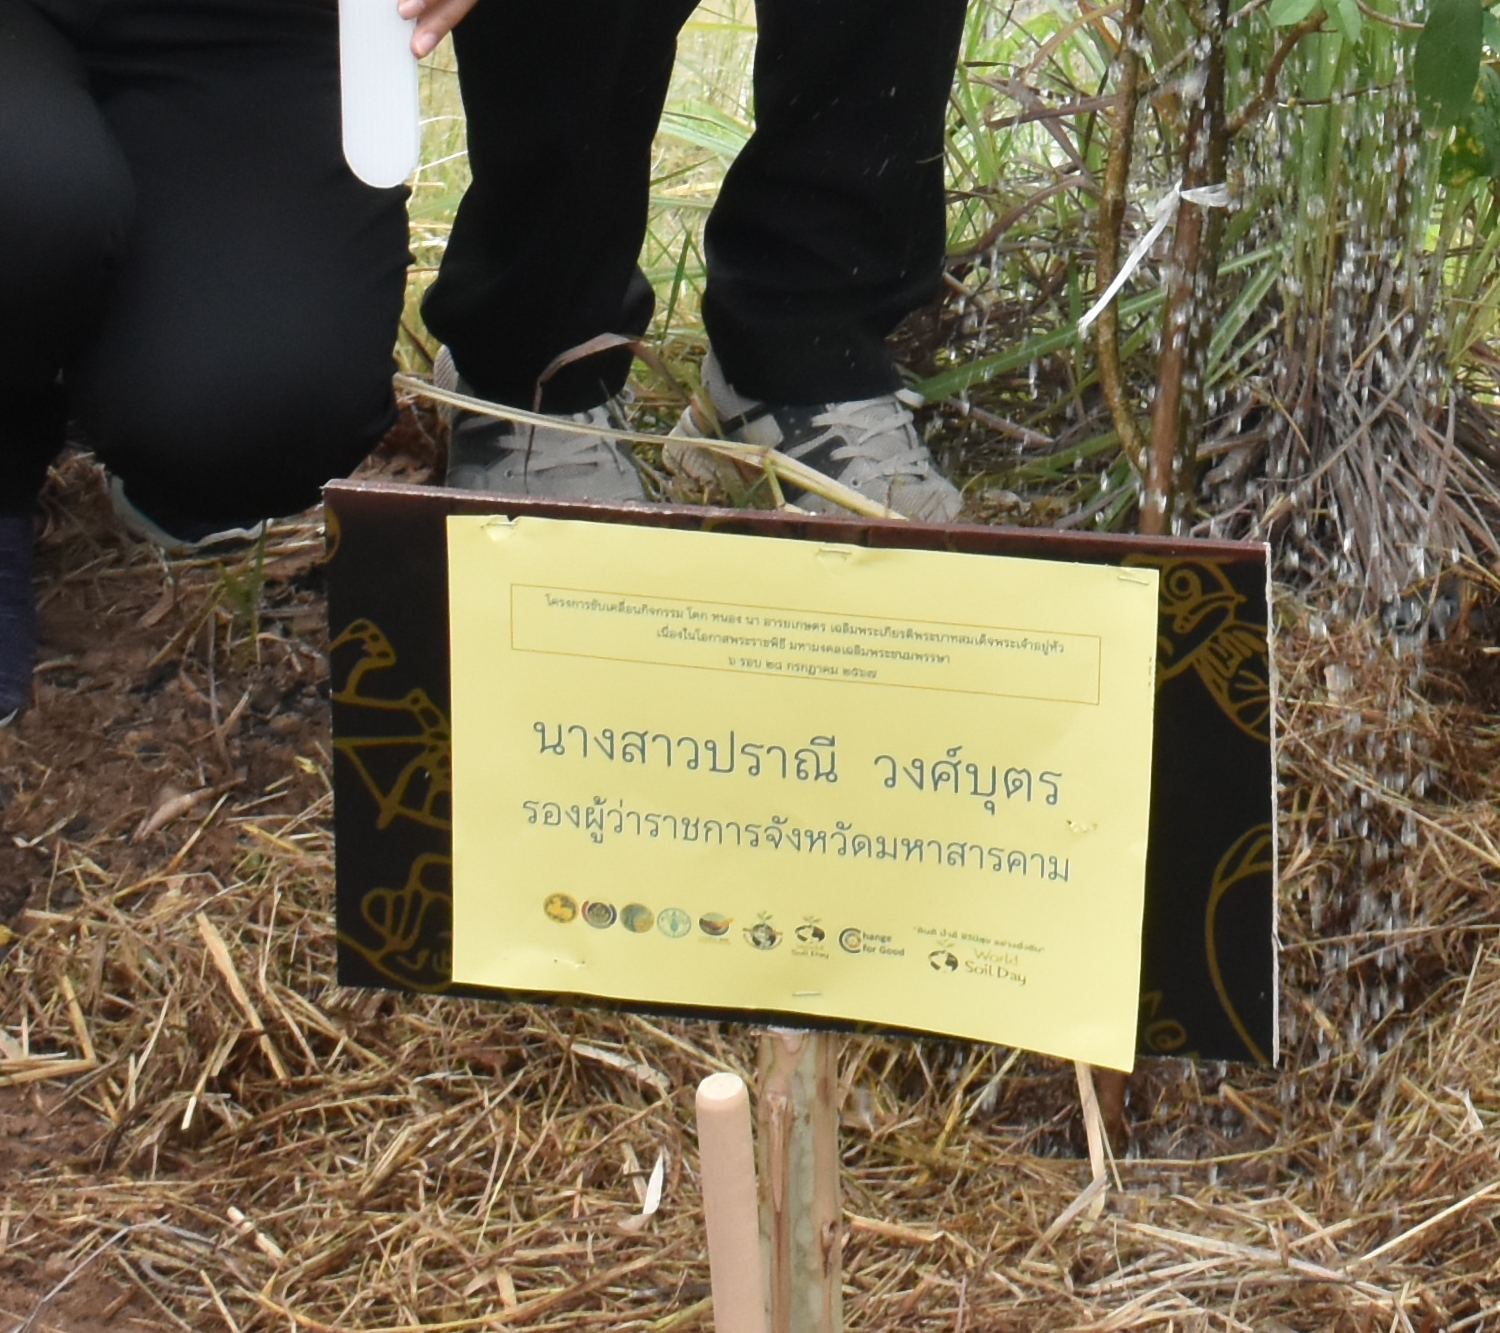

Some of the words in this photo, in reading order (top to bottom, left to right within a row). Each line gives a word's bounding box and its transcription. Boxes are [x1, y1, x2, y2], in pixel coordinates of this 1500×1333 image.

[533, 721, 838, 783] นางสาวปราณี
[874, 745, 1062, 816] วงศ์บุตร
[523, 795, 1069, 882] รองผู้ว่าราชการจังหวัดมหาสารคาม
[863, 943, 876, 954] for
[879, 946, 905, 957] Good
[973, 947, 1018, 966] World
[965, 960, 993, 977] Soil
[997, 966, 1027, 986] Day
